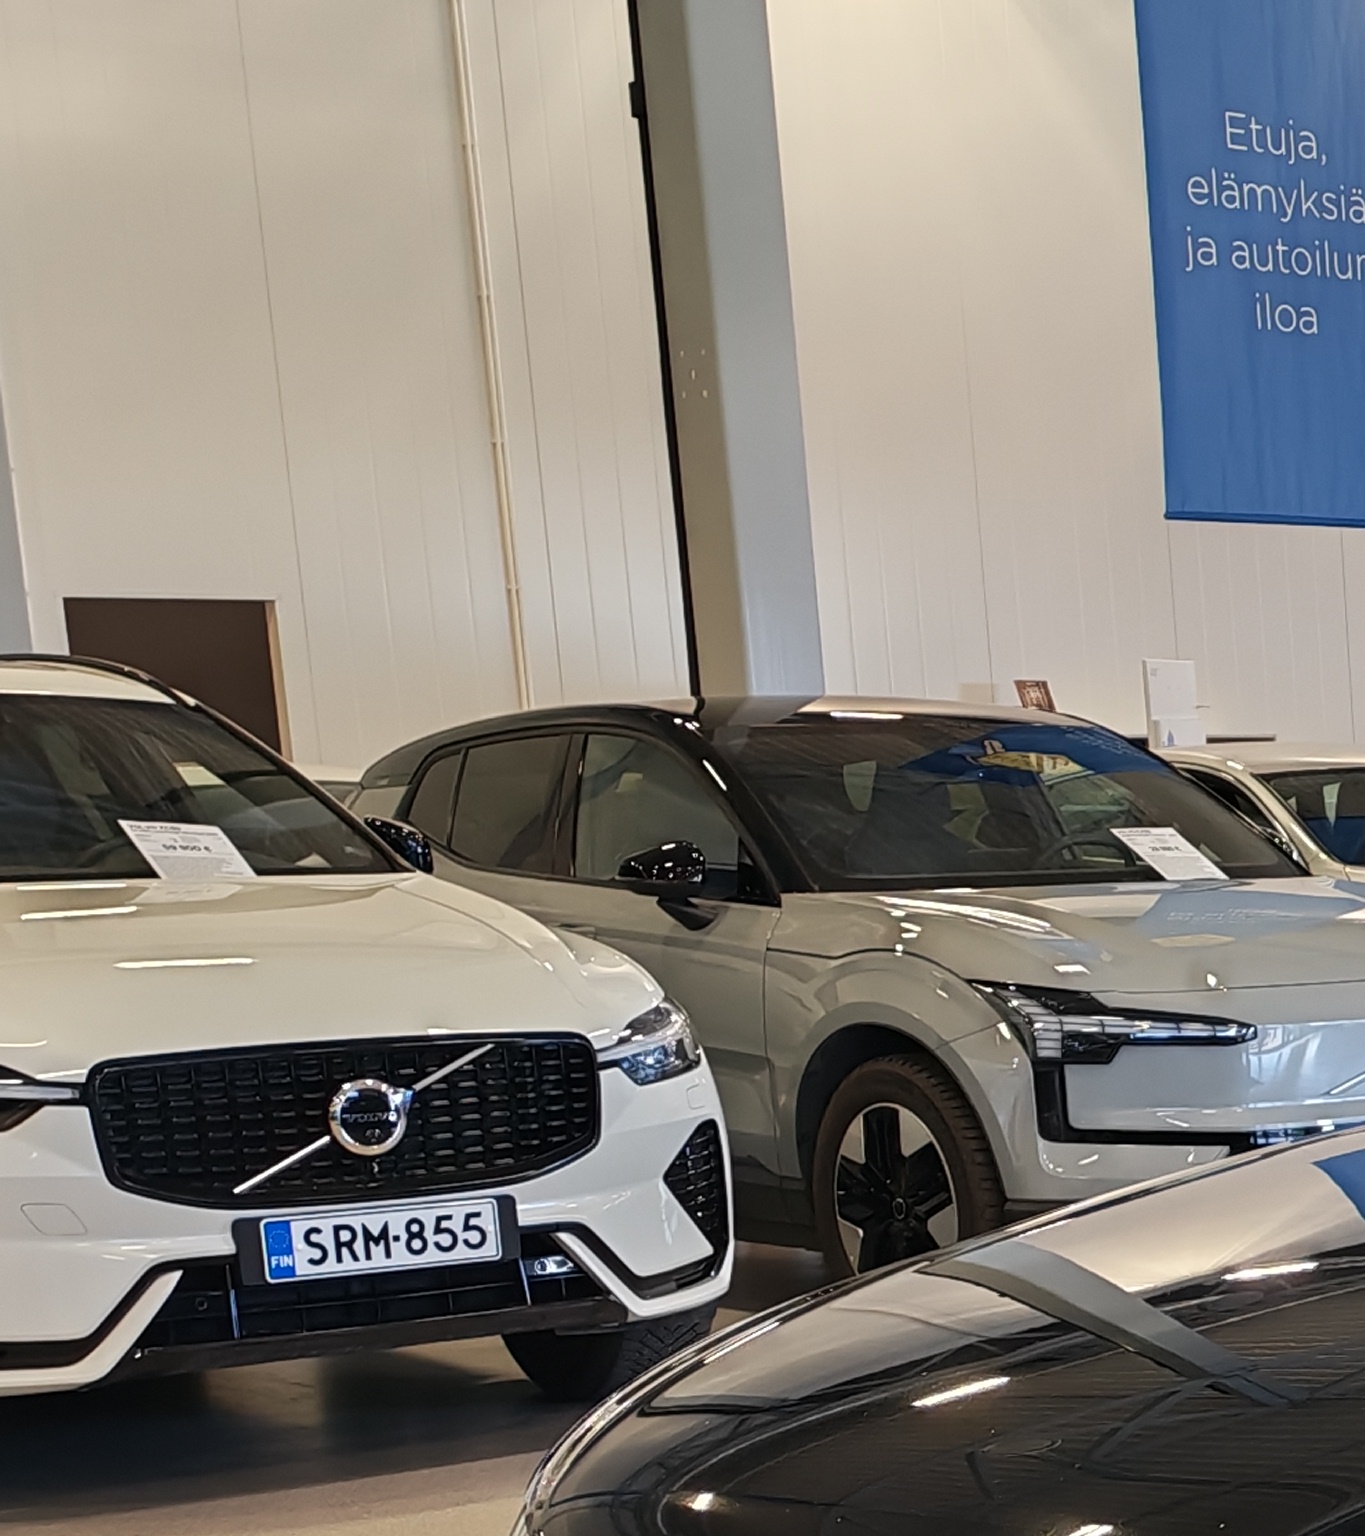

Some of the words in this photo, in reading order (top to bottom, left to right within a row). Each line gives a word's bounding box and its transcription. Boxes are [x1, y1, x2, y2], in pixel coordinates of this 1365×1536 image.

[1224, 110, 1328, 166] Etuja,
[1184, 226, 1218, 272] ja
[1254, 291, 1320, 336] iloa
[303, 1212, 487, 1267] SRM-855
[270, 1255, 293, 1271] FIN
